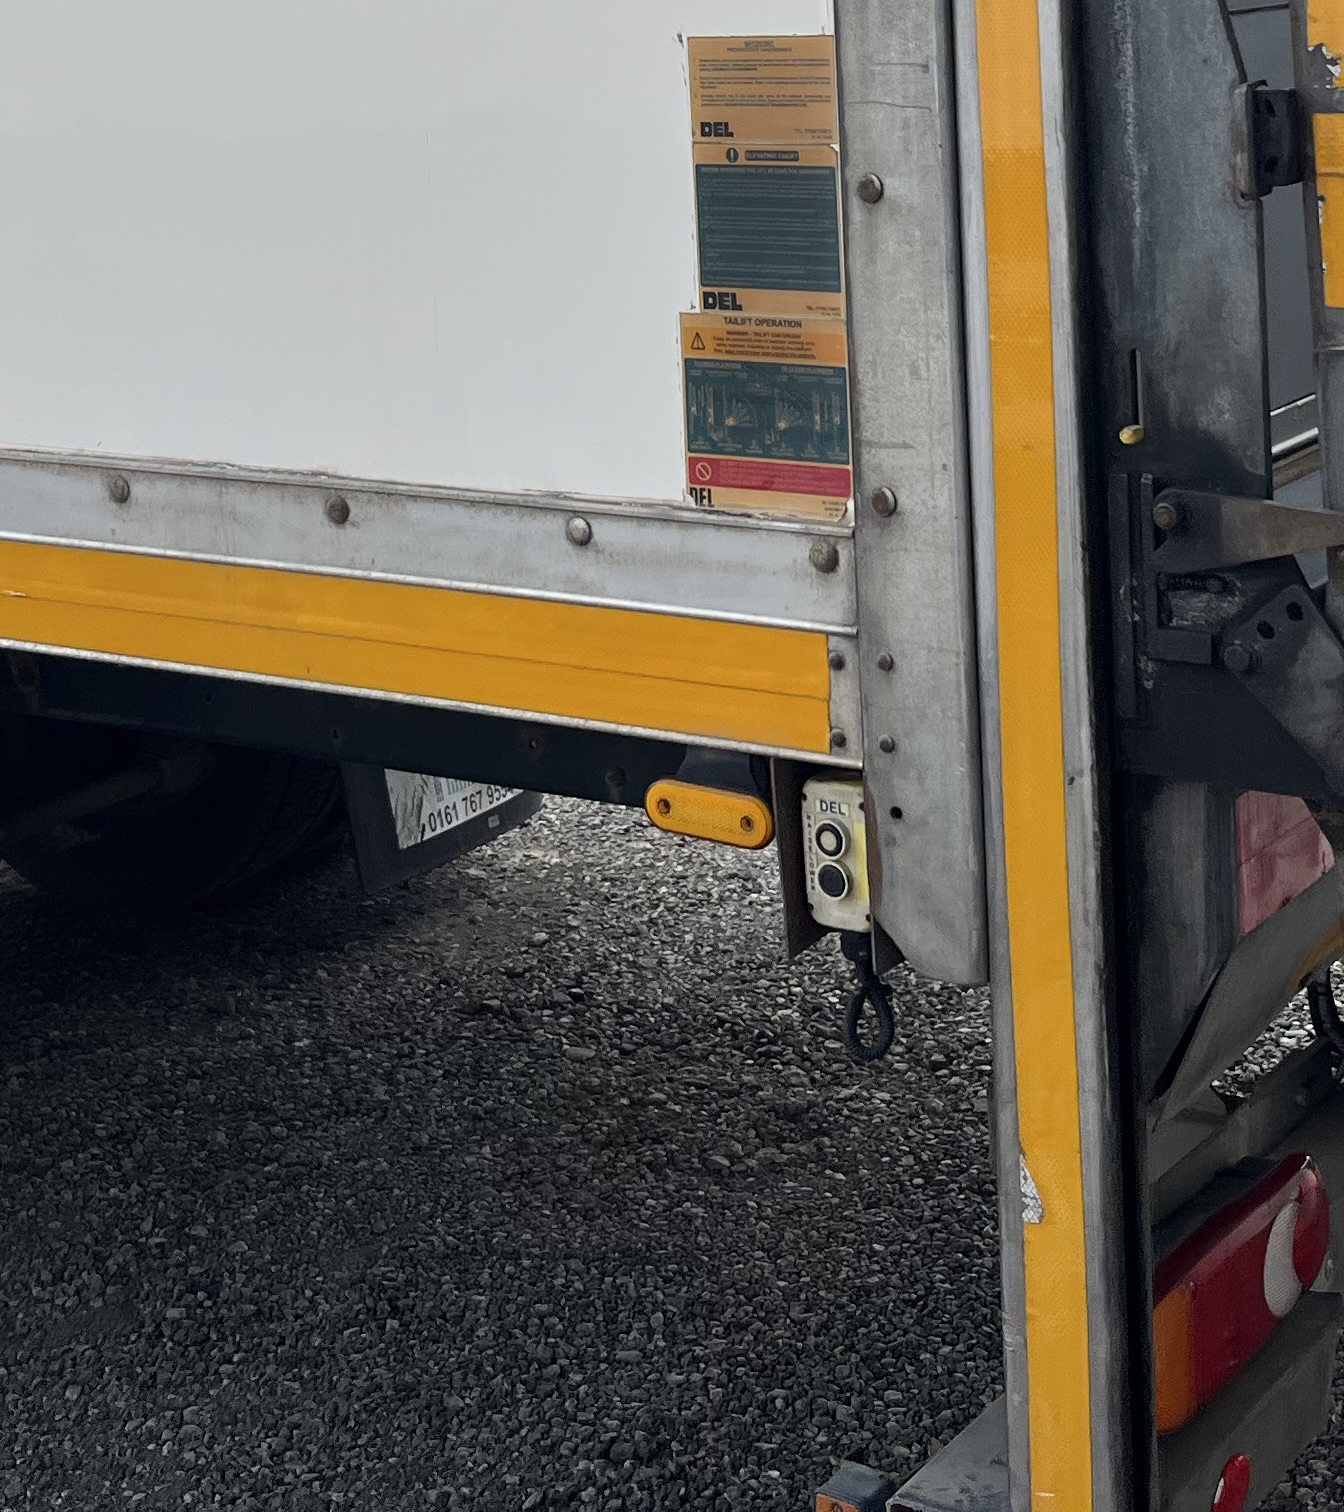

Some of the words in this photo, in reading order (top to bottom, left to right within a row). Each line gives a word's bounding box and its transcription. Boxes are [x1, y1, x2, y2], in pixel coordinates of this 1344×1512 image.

[700, 122, 734, 137] DEL
[702, 291, 743, 311] DEL
[754, 318, 802, 328] OPERATION
[428, 801, 459, 833] 0161
[461, 790, 483, 817] 767
[487, 785, 514, 805] 955
[820, 799, 846, 816] DEL
